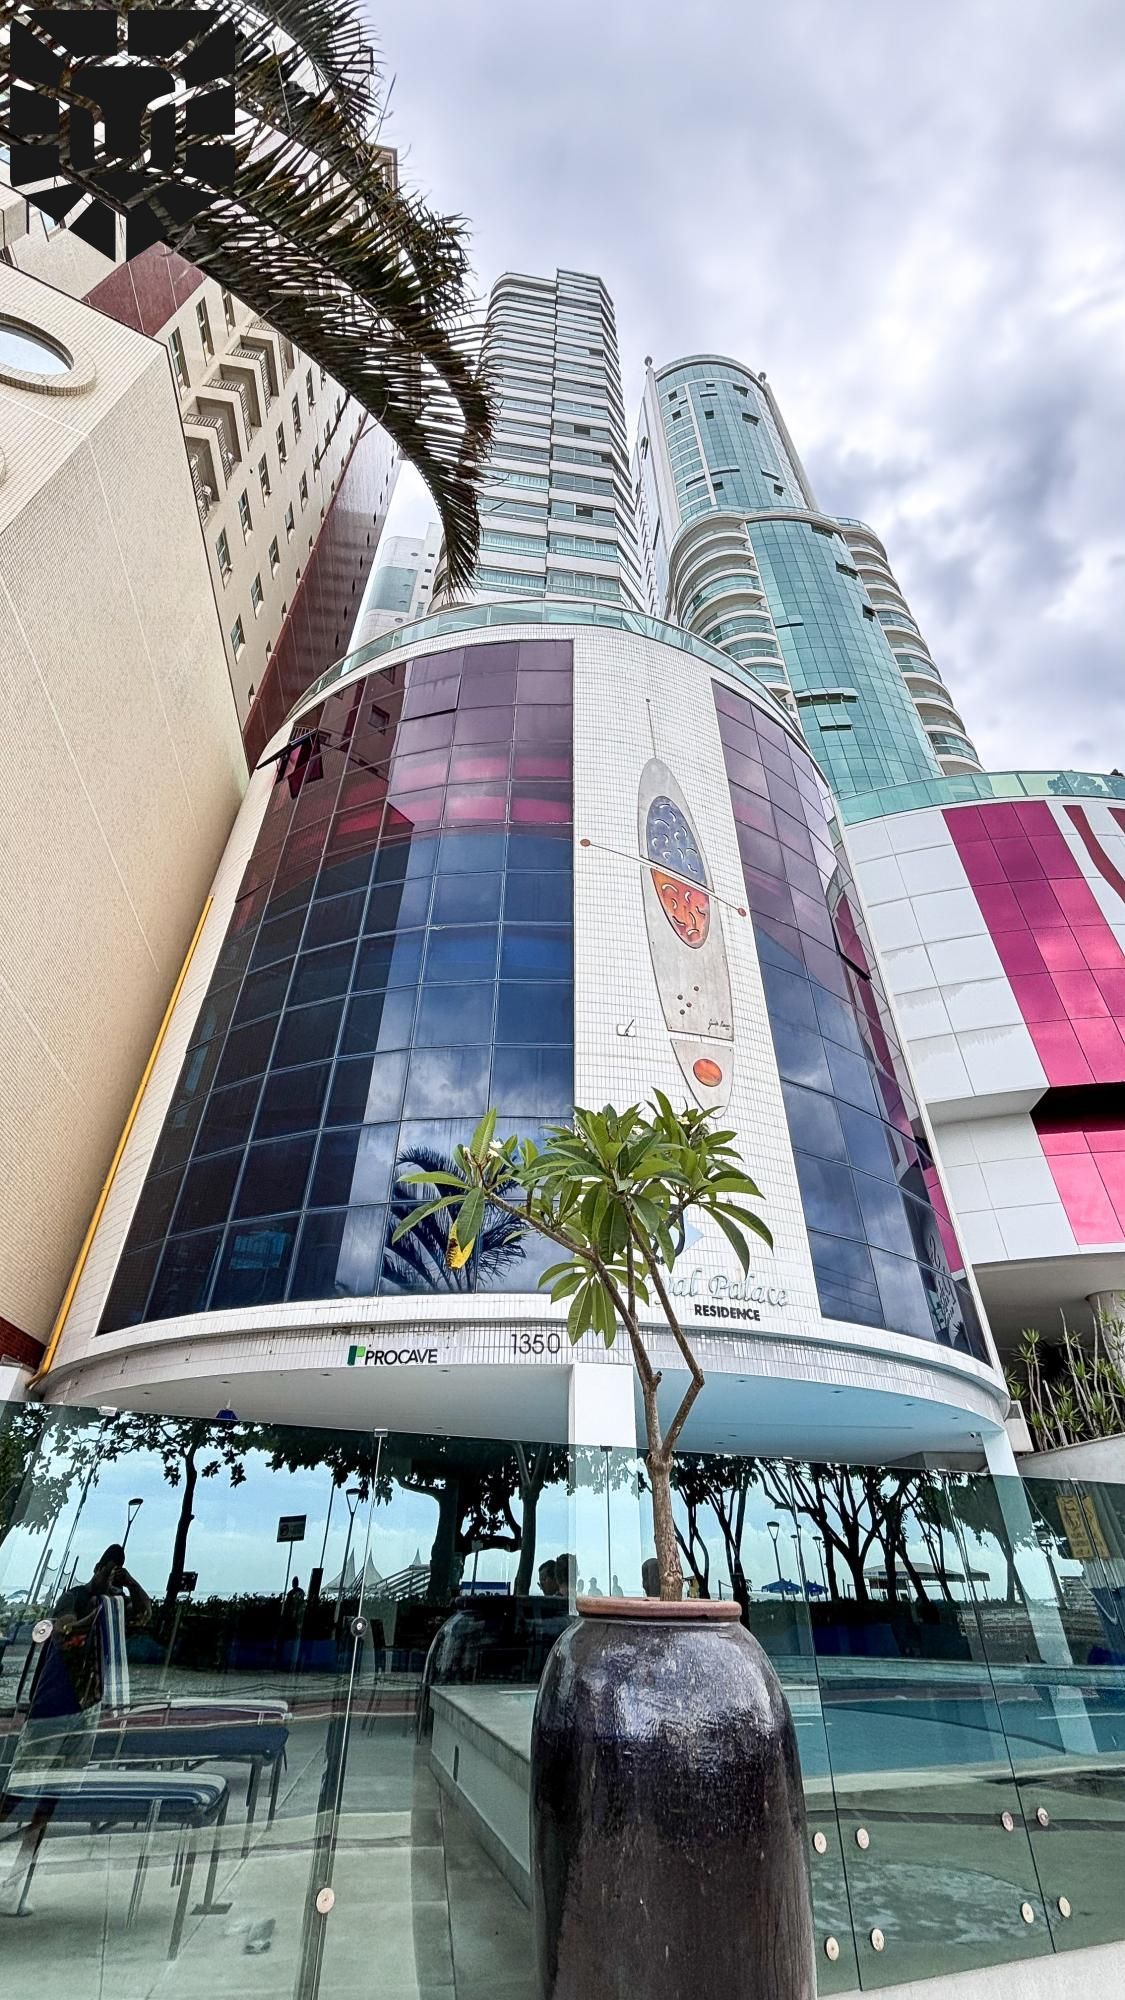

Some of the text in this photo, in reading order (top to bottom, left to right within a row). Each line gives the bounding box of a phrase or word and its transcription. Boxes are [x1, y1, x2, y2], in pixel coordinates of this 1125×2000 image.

[708, 1275, 789, 1306] Palace
[694, 1304, 761, 1321] RESIDENCE
[511, 1333, 560, 1355] 1350
[364, 1348, 438, 1365] PROCAVE
